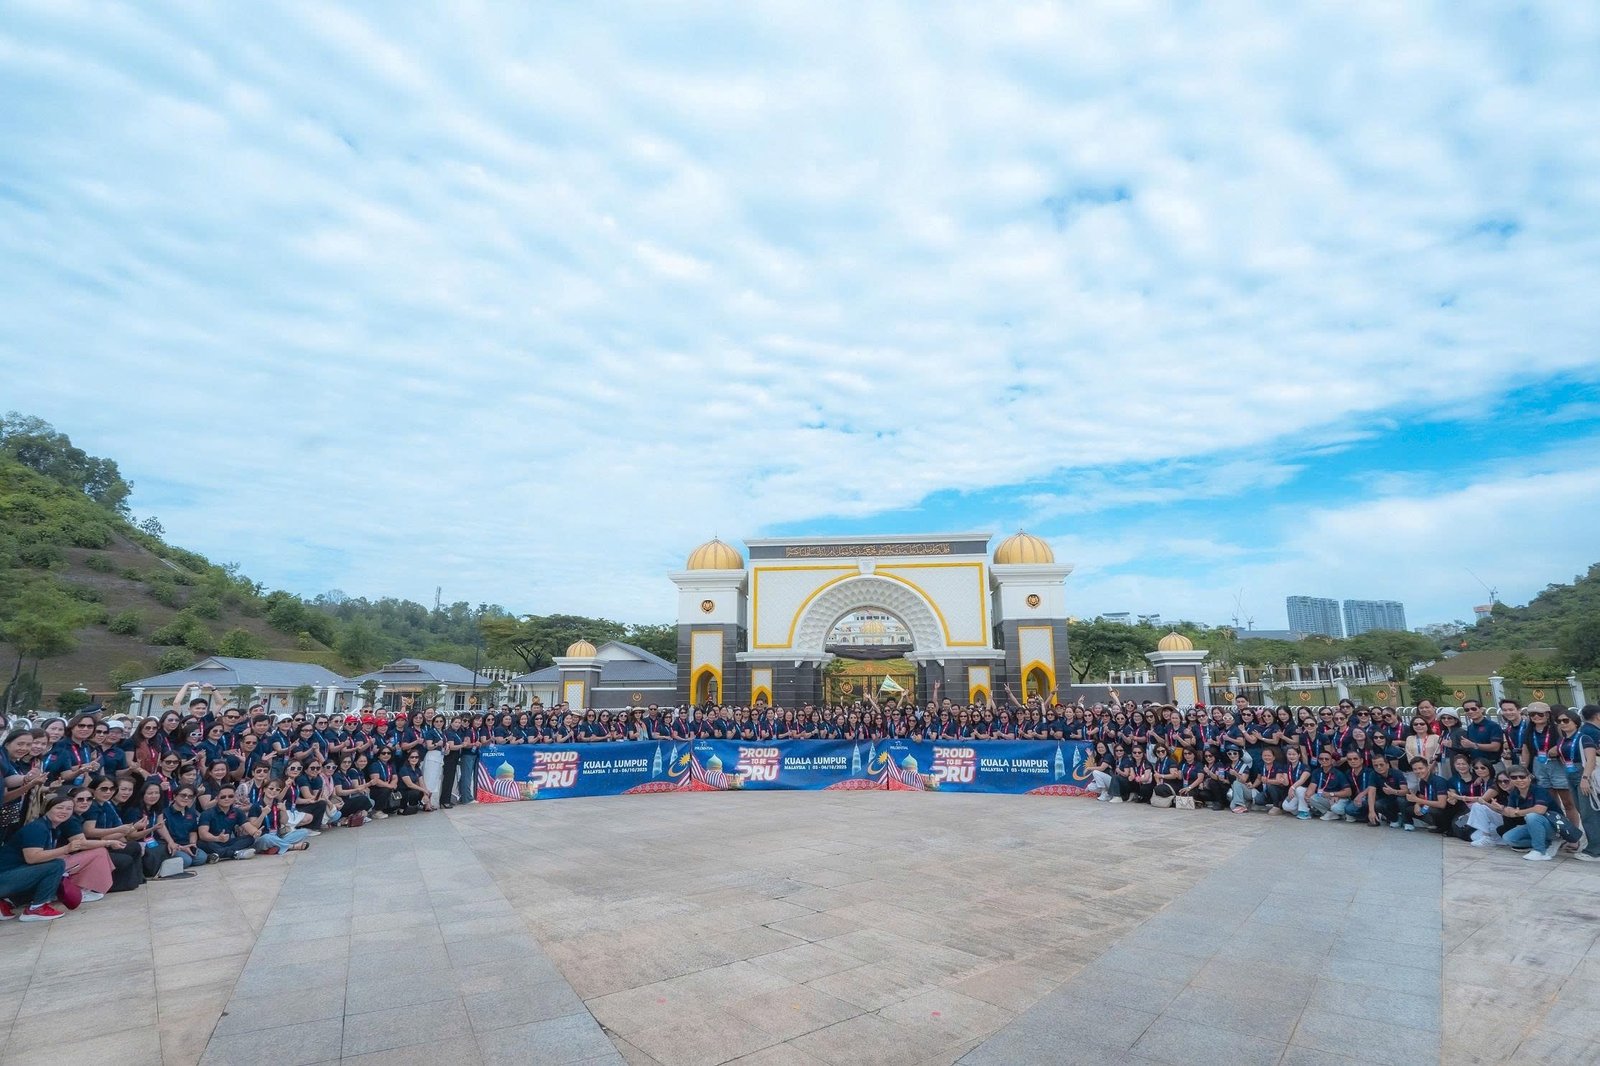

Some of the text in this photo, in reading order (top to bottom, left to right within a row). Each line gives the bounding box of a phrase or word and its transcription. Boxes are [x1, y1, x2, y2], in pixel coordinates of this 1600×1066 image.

[534, 751, 578, 763] PROUD
[739, 747, 779, 758] PROUD
[933, 746, 975, 758] PROUD
[584, 759, 648, 769] KUALA LUMPUR
[1012, 760, 1048, 768] LUMPUR
[735, 764, 779, 781] PRU
[930, 766, 975, 782] PRU
[530, 770, 577, 788] PRU
